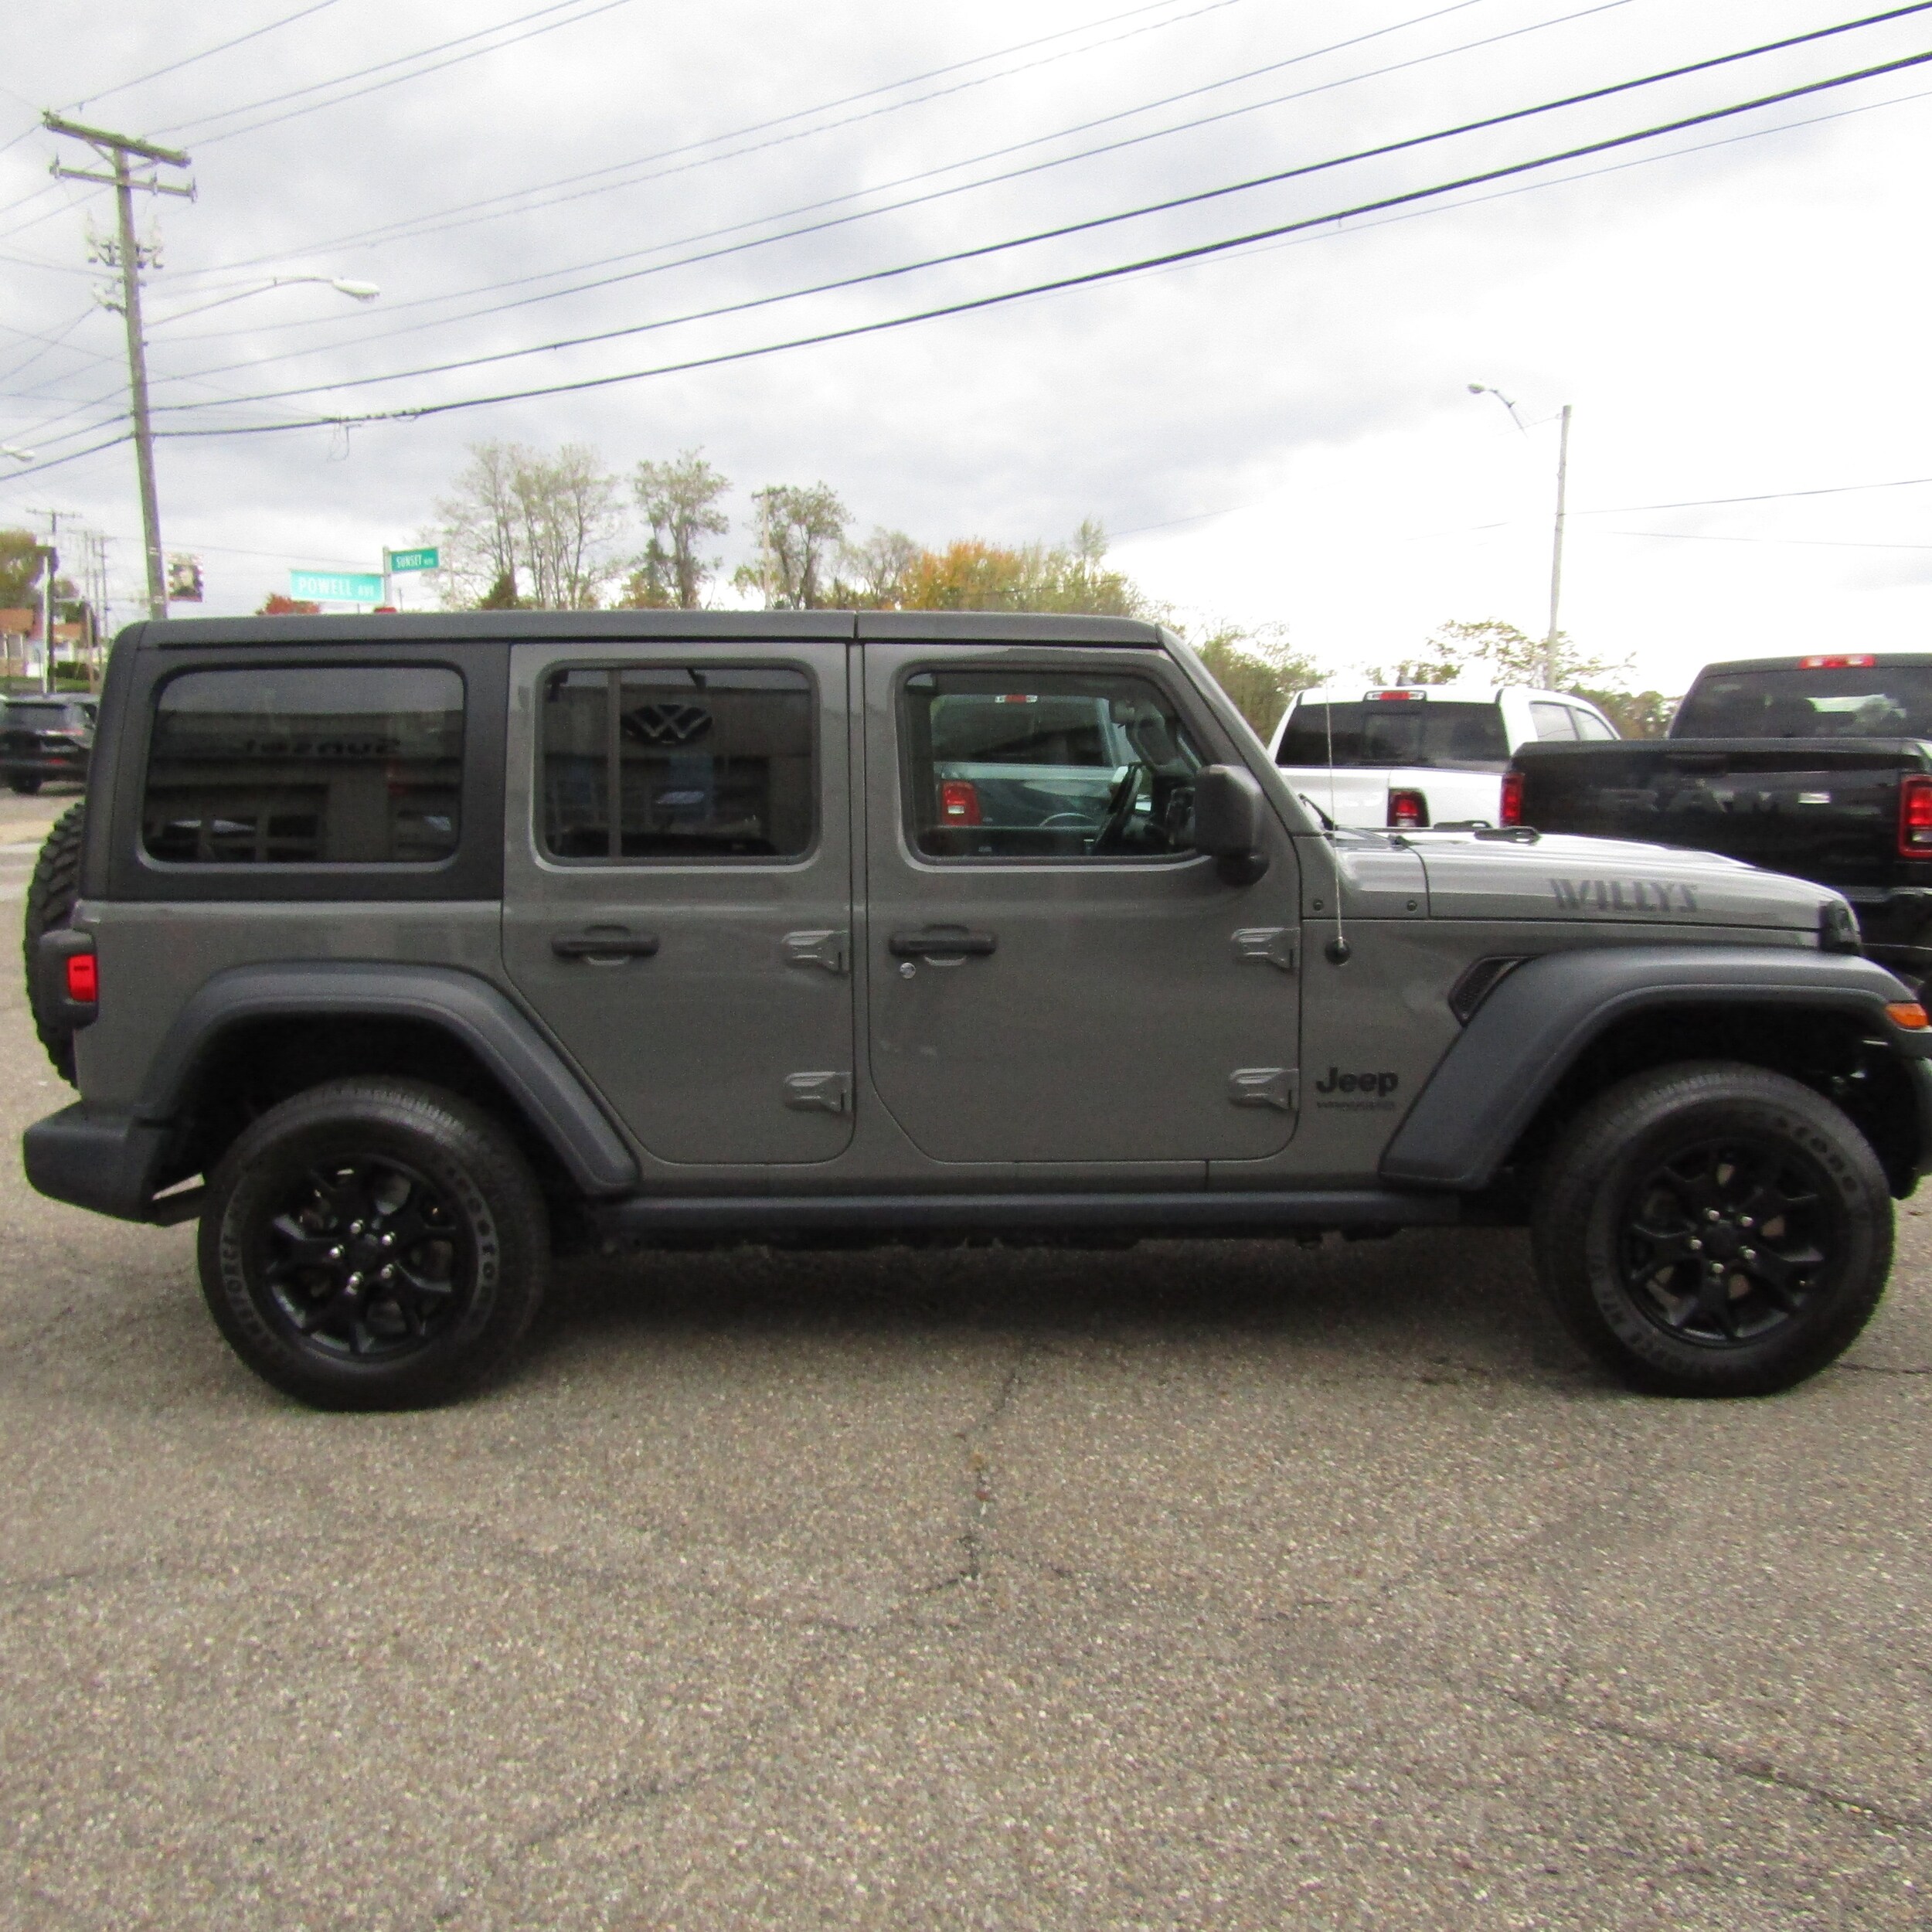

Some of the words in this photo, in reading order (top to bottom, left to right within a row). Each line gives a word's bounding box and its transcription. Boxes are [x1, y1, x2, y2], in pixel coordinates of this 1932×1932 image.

[396, 554, 422, 568] SUNSET
[298, 577, 352, 597] POWELL
[358, 584, 375, 597] AVE
[1598, 787, 1799, 814] RAM
[1549, 879, 1699, 913] WILLYS
[1315, 1066, 1400, 1097] Jeep
